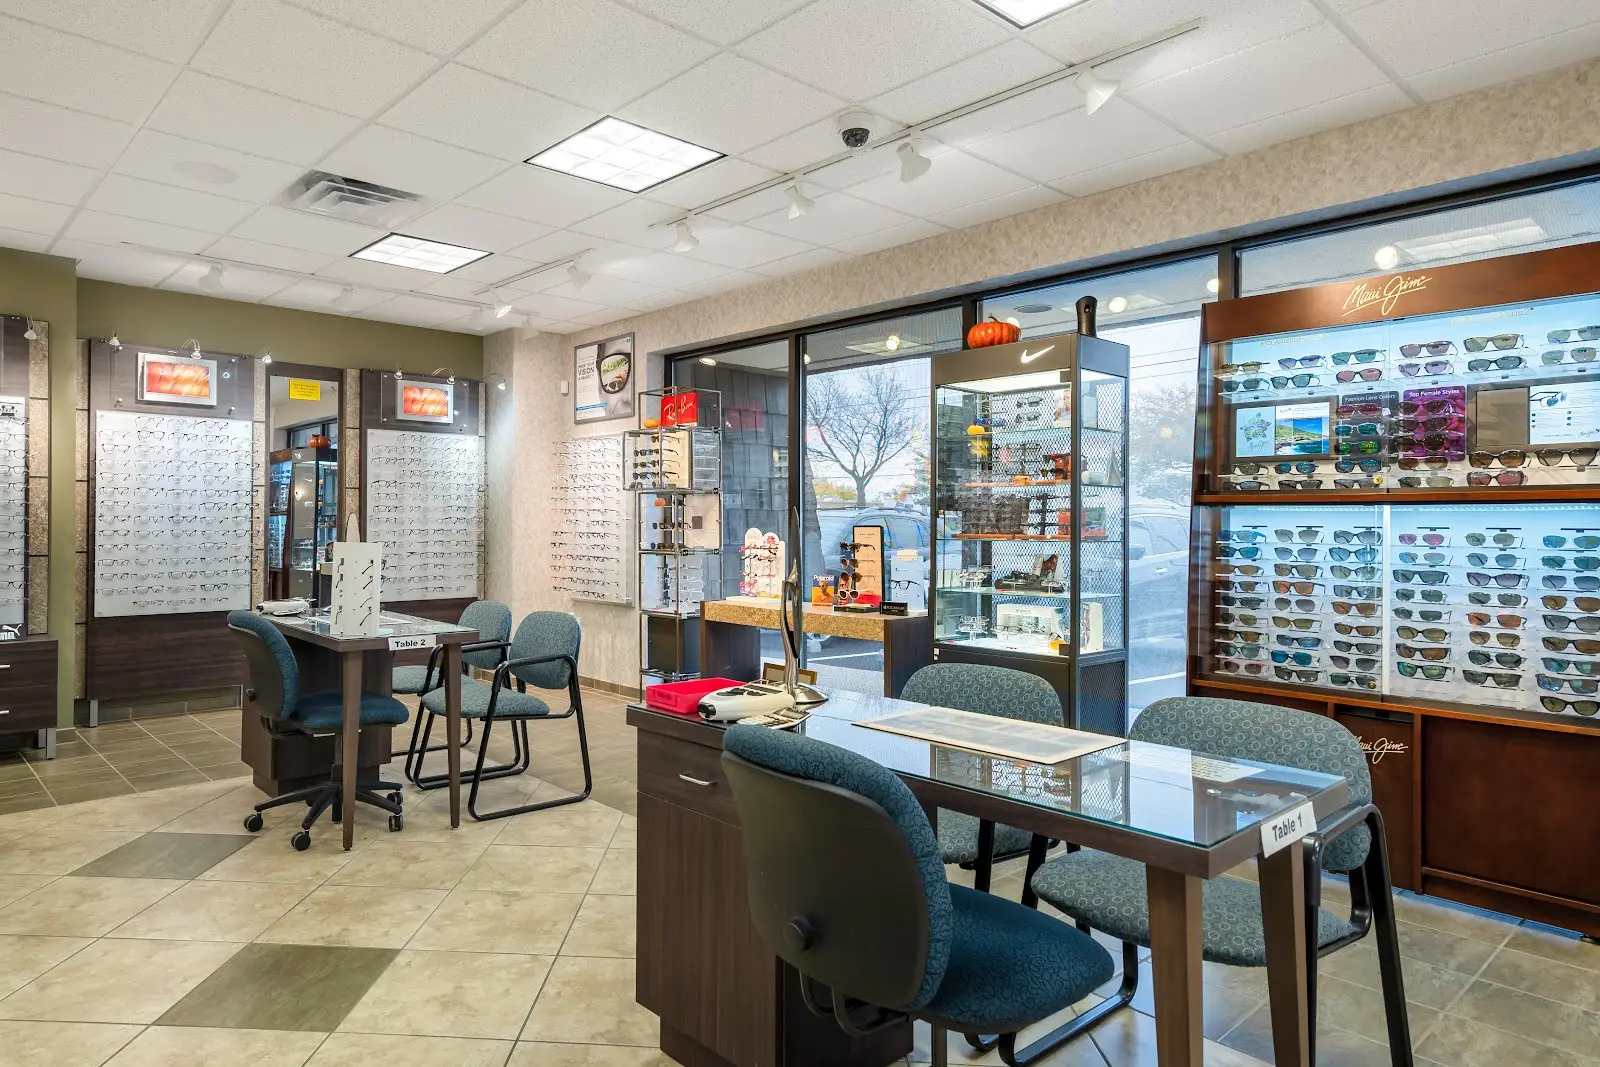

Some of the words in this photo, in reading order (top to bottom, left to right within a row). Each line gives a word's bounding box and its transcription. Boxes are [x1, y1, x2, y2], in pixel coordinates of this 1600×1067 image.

[1342, 283, 1380, 310] Maui
[1382, 275, 1432, 316] Jim
[1344, 395, 1365, 403] Fashion
[1378, 393, 1396, 401] Colors
[1420, 389, 1441, 397] Female
[1442, 388, 1460, 396] Styles
[663, 395, 694, 421] Ra-Ban
[394, 639, 418, 648] Table
[420, 638, 426, 646] 2
[1372, 737, 1409, 765] Jim
[1271, 817, 1296, 842] Table
[1297, 811, 1303, 829] 1
